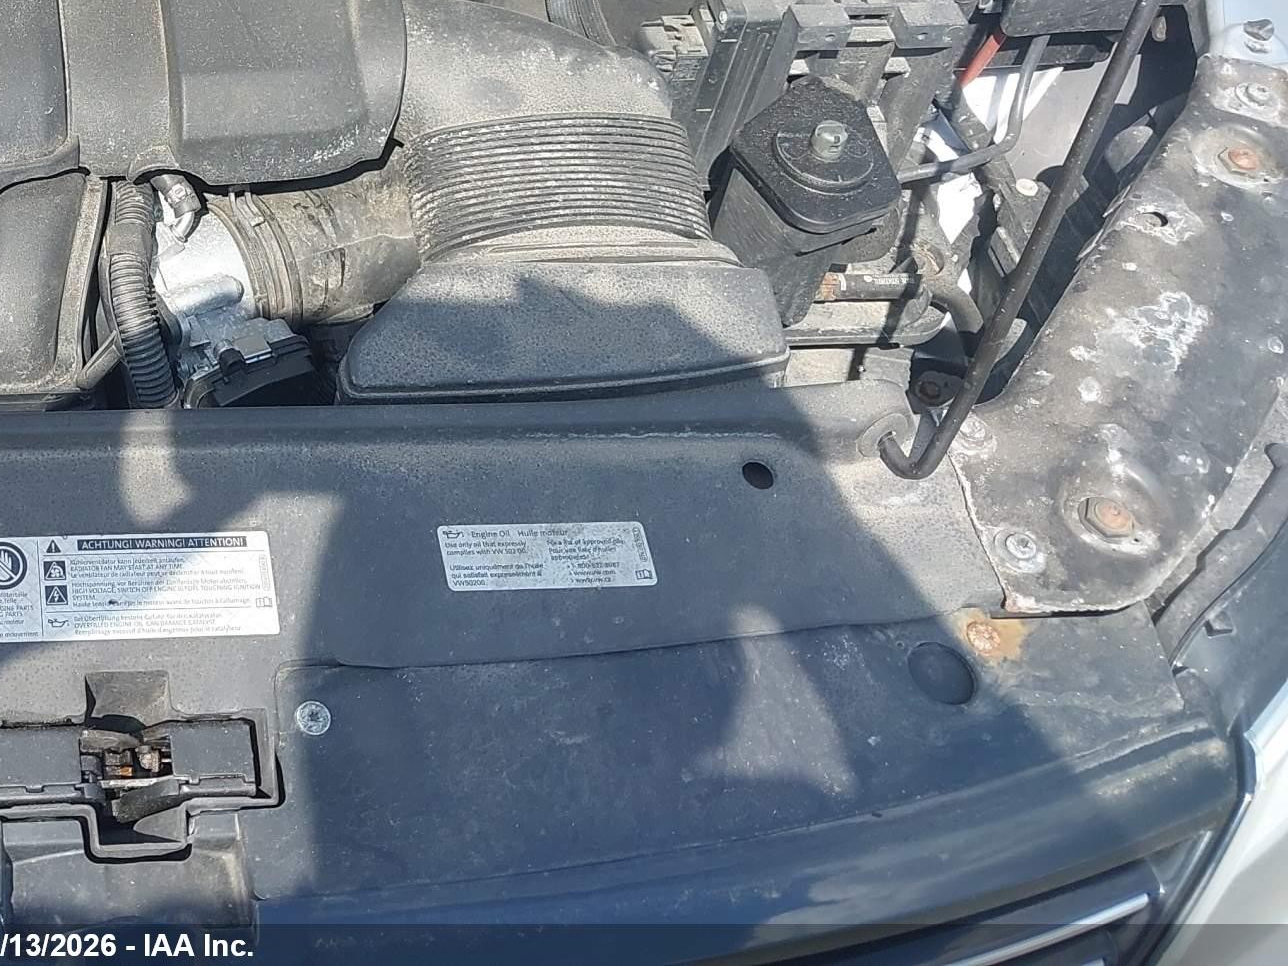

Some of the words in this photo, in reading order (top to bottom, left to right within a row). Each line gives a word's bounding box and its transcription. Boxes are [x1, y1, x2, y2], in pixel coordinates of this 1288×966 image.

[471, 530, 497, 539] Engine
[499, 529, 510, 538] Oil
[81, 539, 133, 550] ACHTUNG!
[134, 538, 186, 549] WARNING!
[187, 536, 245, 548] ATTENTION!
